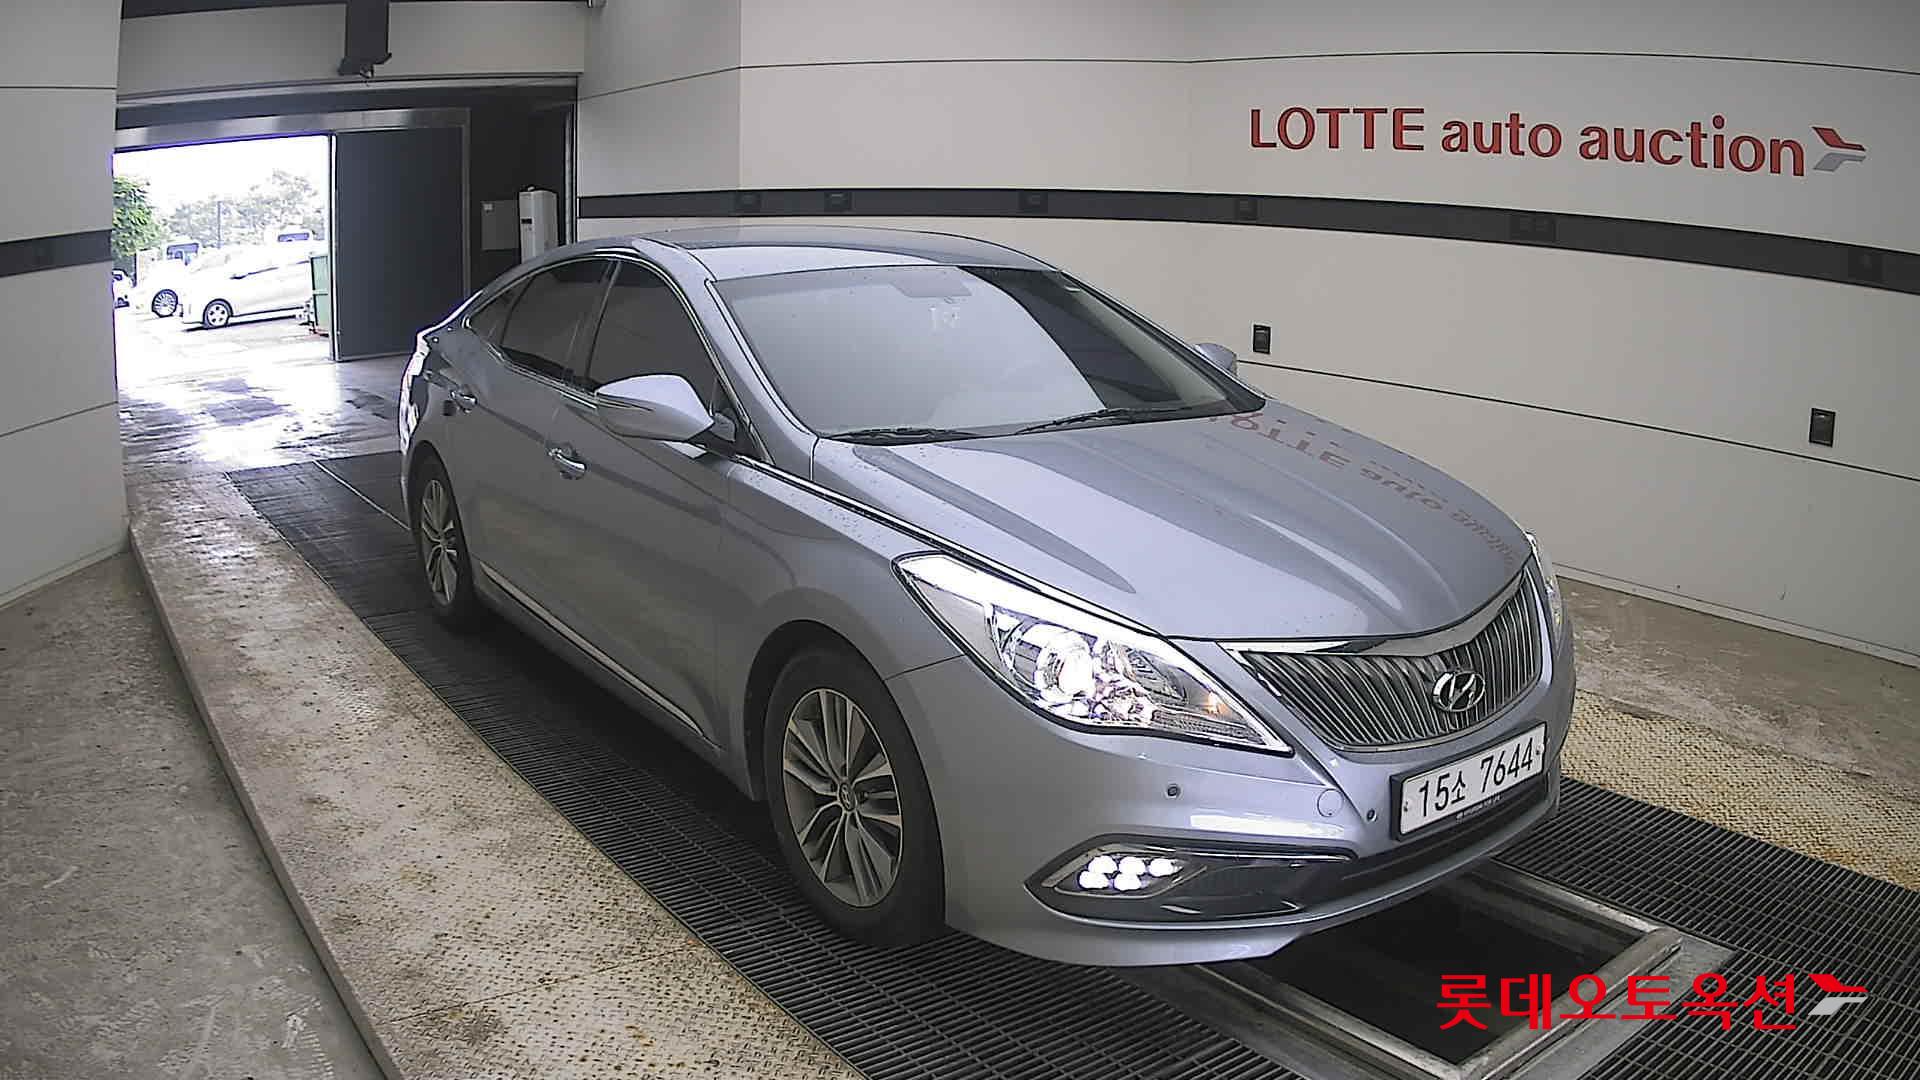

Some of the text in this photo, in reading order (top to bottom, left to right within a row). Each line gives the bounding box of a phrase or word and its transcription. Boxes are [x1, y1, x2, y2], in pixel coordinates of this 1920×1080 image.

[1250, 106, 1805, 177] LOTTE auto auction
[1418, 770, 1466, 817] 15소
[1480, 737, 1533, 793] 7644
